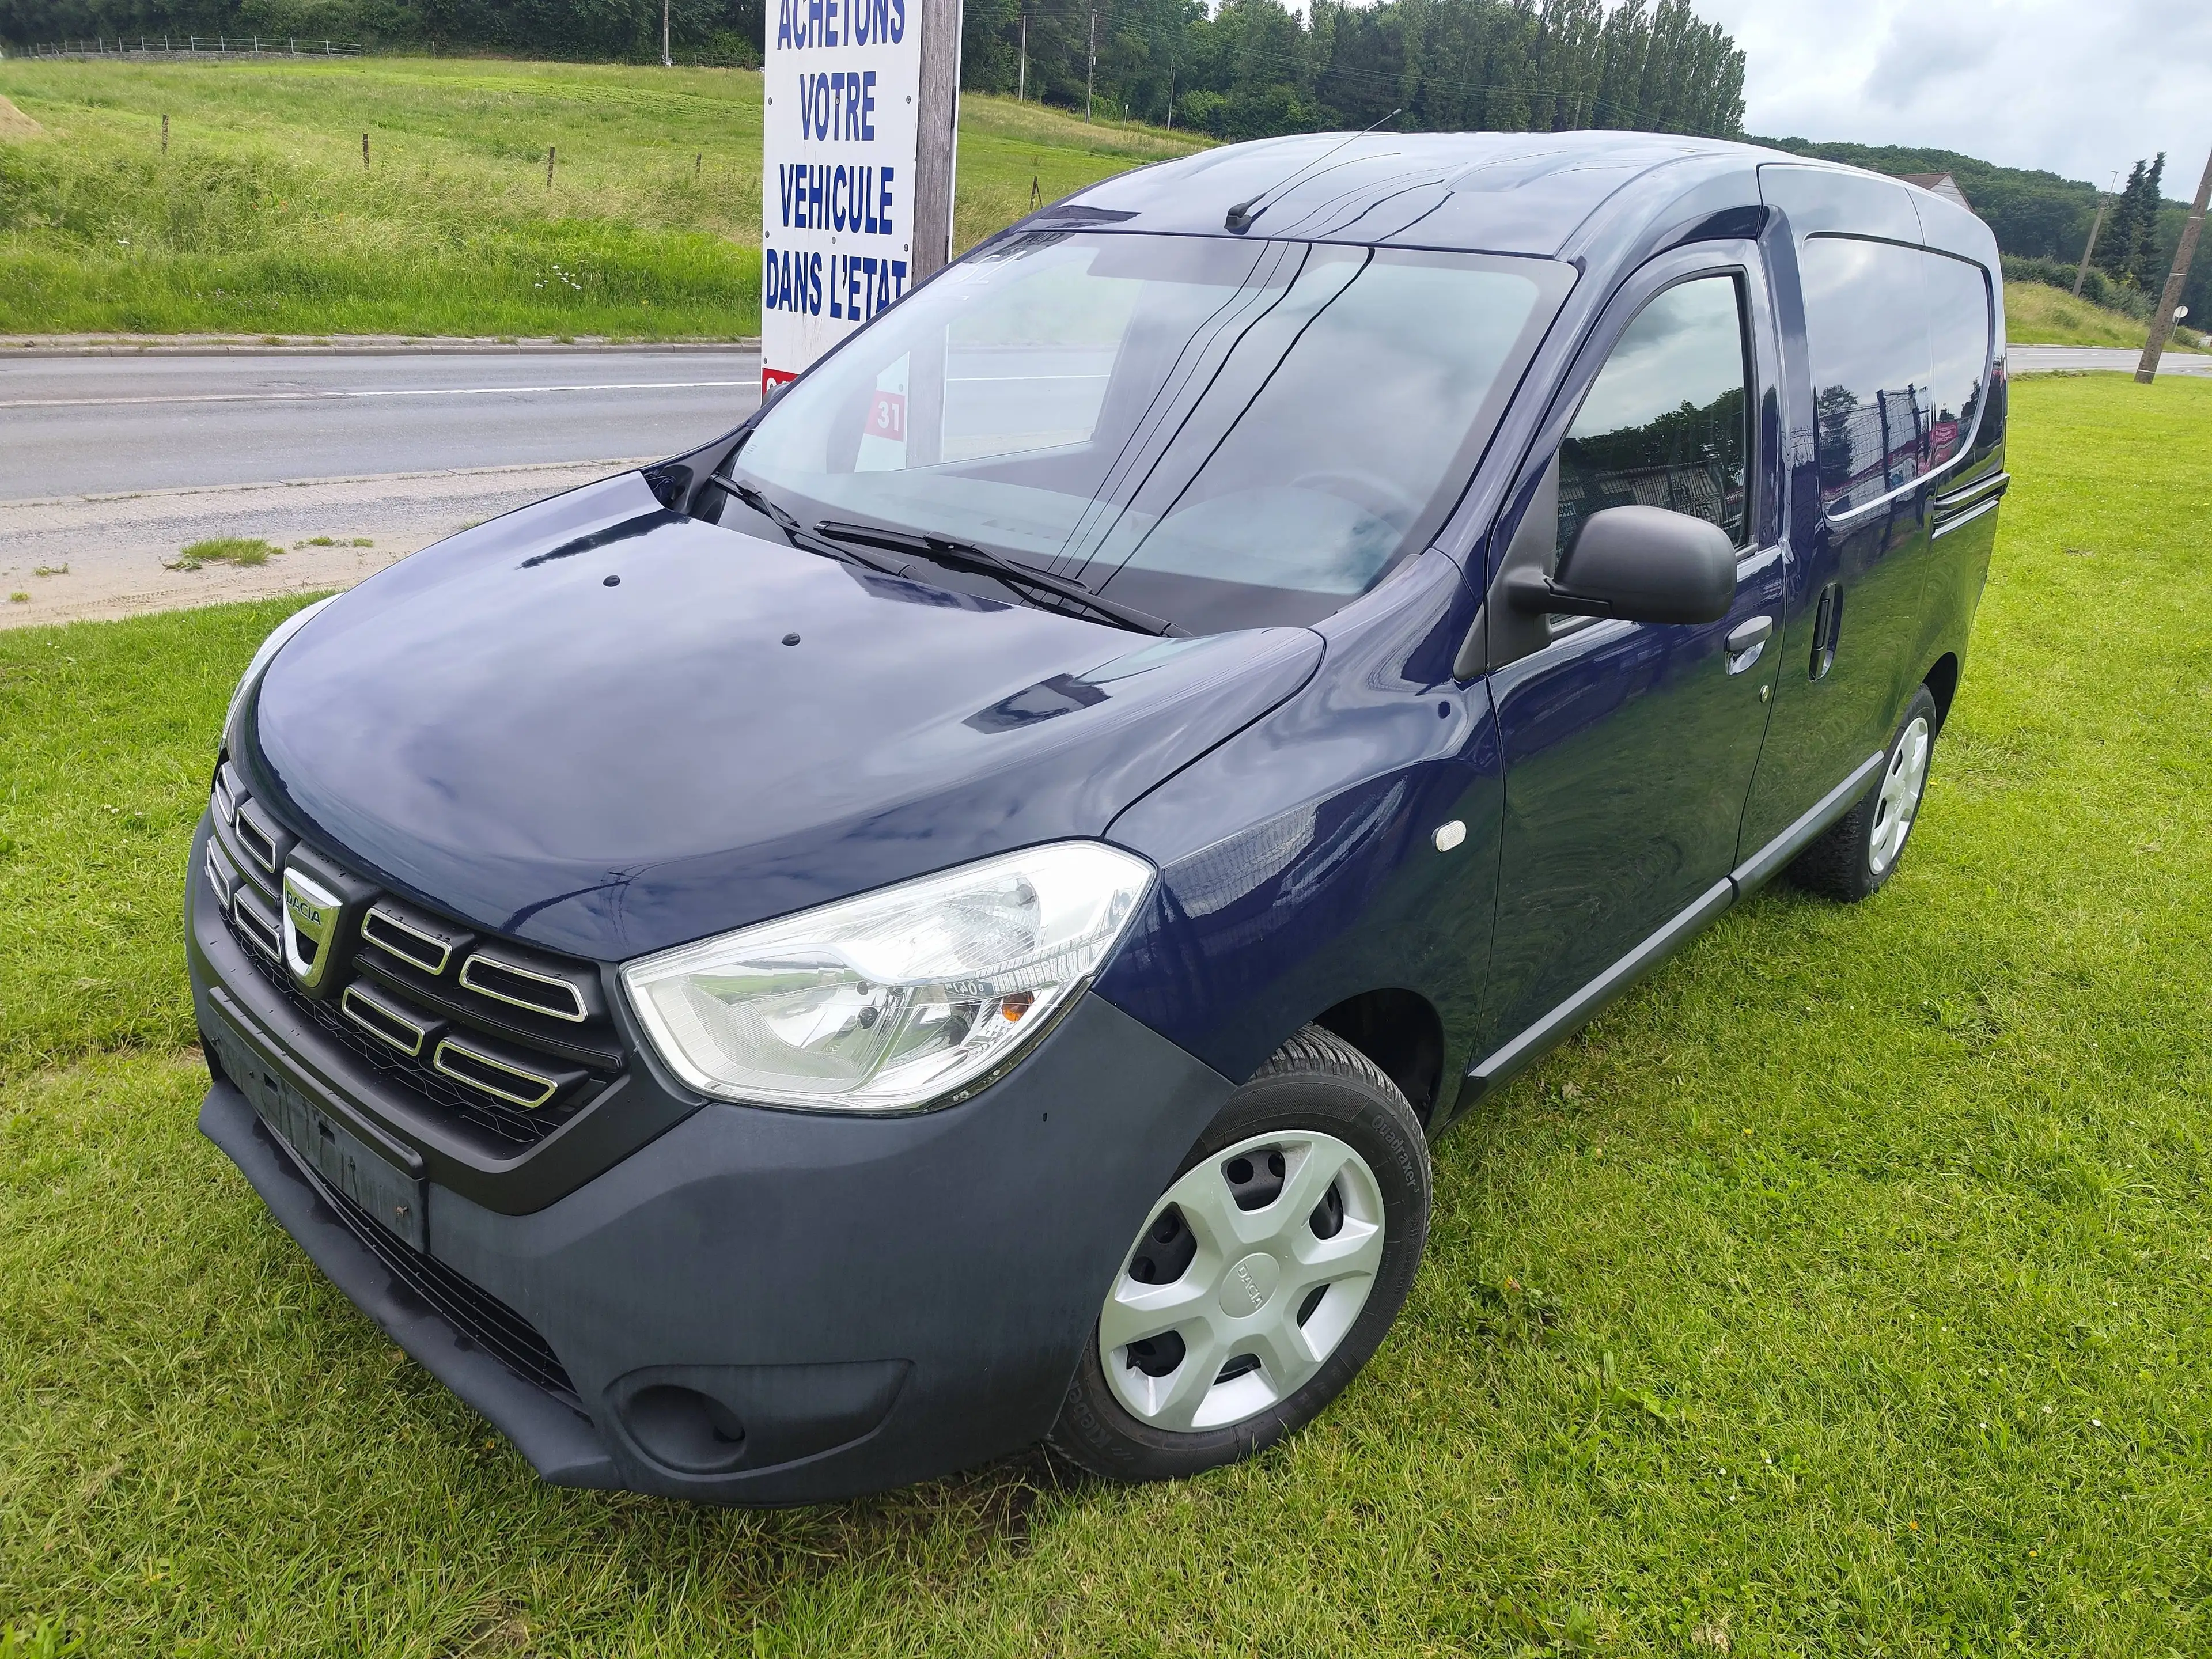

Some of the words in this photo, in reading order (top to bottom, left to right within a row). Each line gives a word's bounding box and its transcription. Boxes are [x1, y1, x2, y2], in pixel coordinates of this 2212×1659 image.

[800, 71, 876, 142] VOTRE
[779, 164, 894, 235] VEHICULE
[766, 249, 822, 316] DANS
[830, 255, 907, 322] L'ETAT
[878, 401, 899, 431] 31
[286, 890, 322, 926] DACIA
[1236, 1262, 1263, 1309] DACIA
